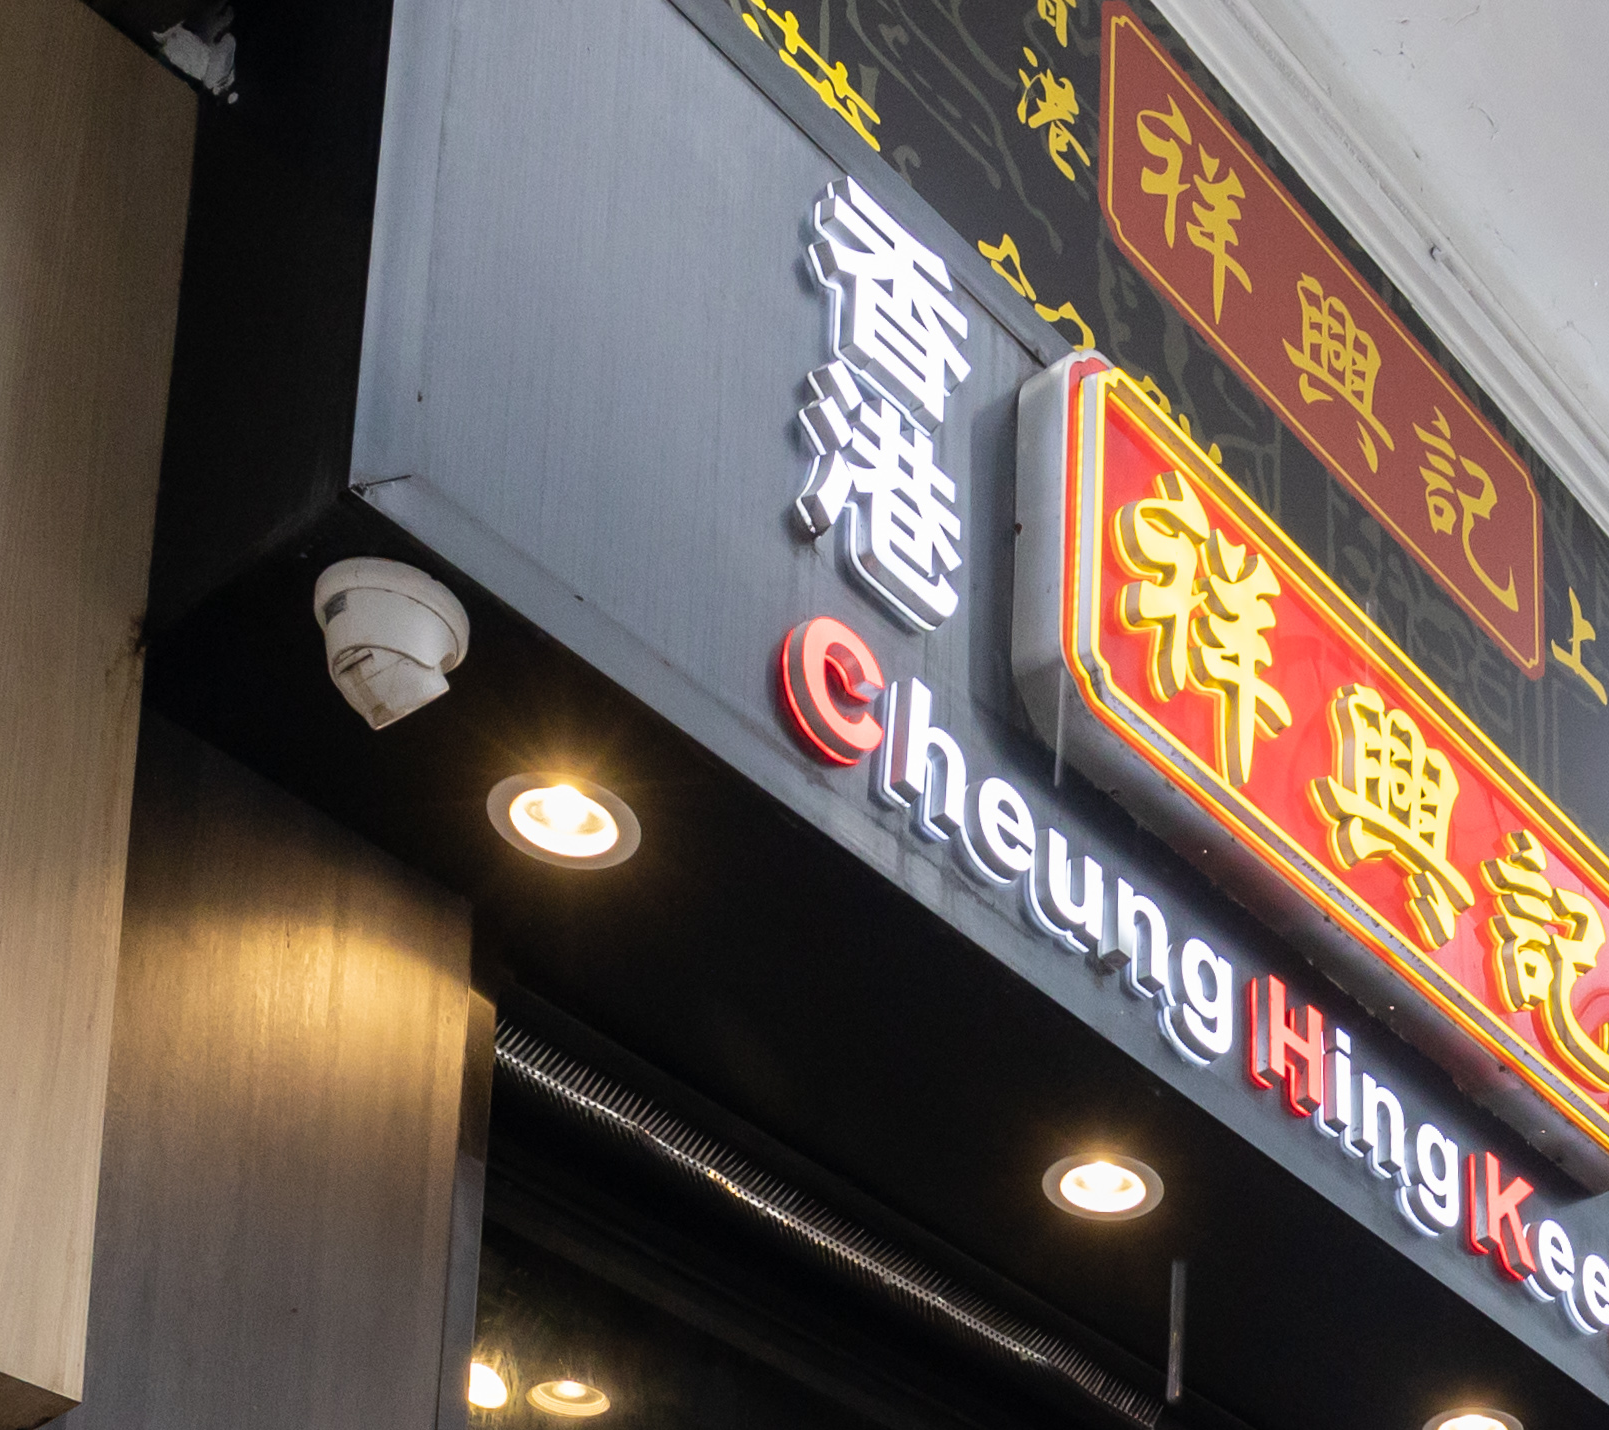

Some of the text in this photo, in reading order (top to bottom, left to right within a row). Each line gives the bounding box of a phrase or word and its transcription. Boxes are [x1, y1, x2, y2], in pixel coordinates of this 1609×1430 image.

[796, 175, 972, 633] 香港
[1137, 95, 1518, 614] 祥興記
[779, 615, 1237, 1066] Cheung
[1244, 972, 1461, 1236] Hing
